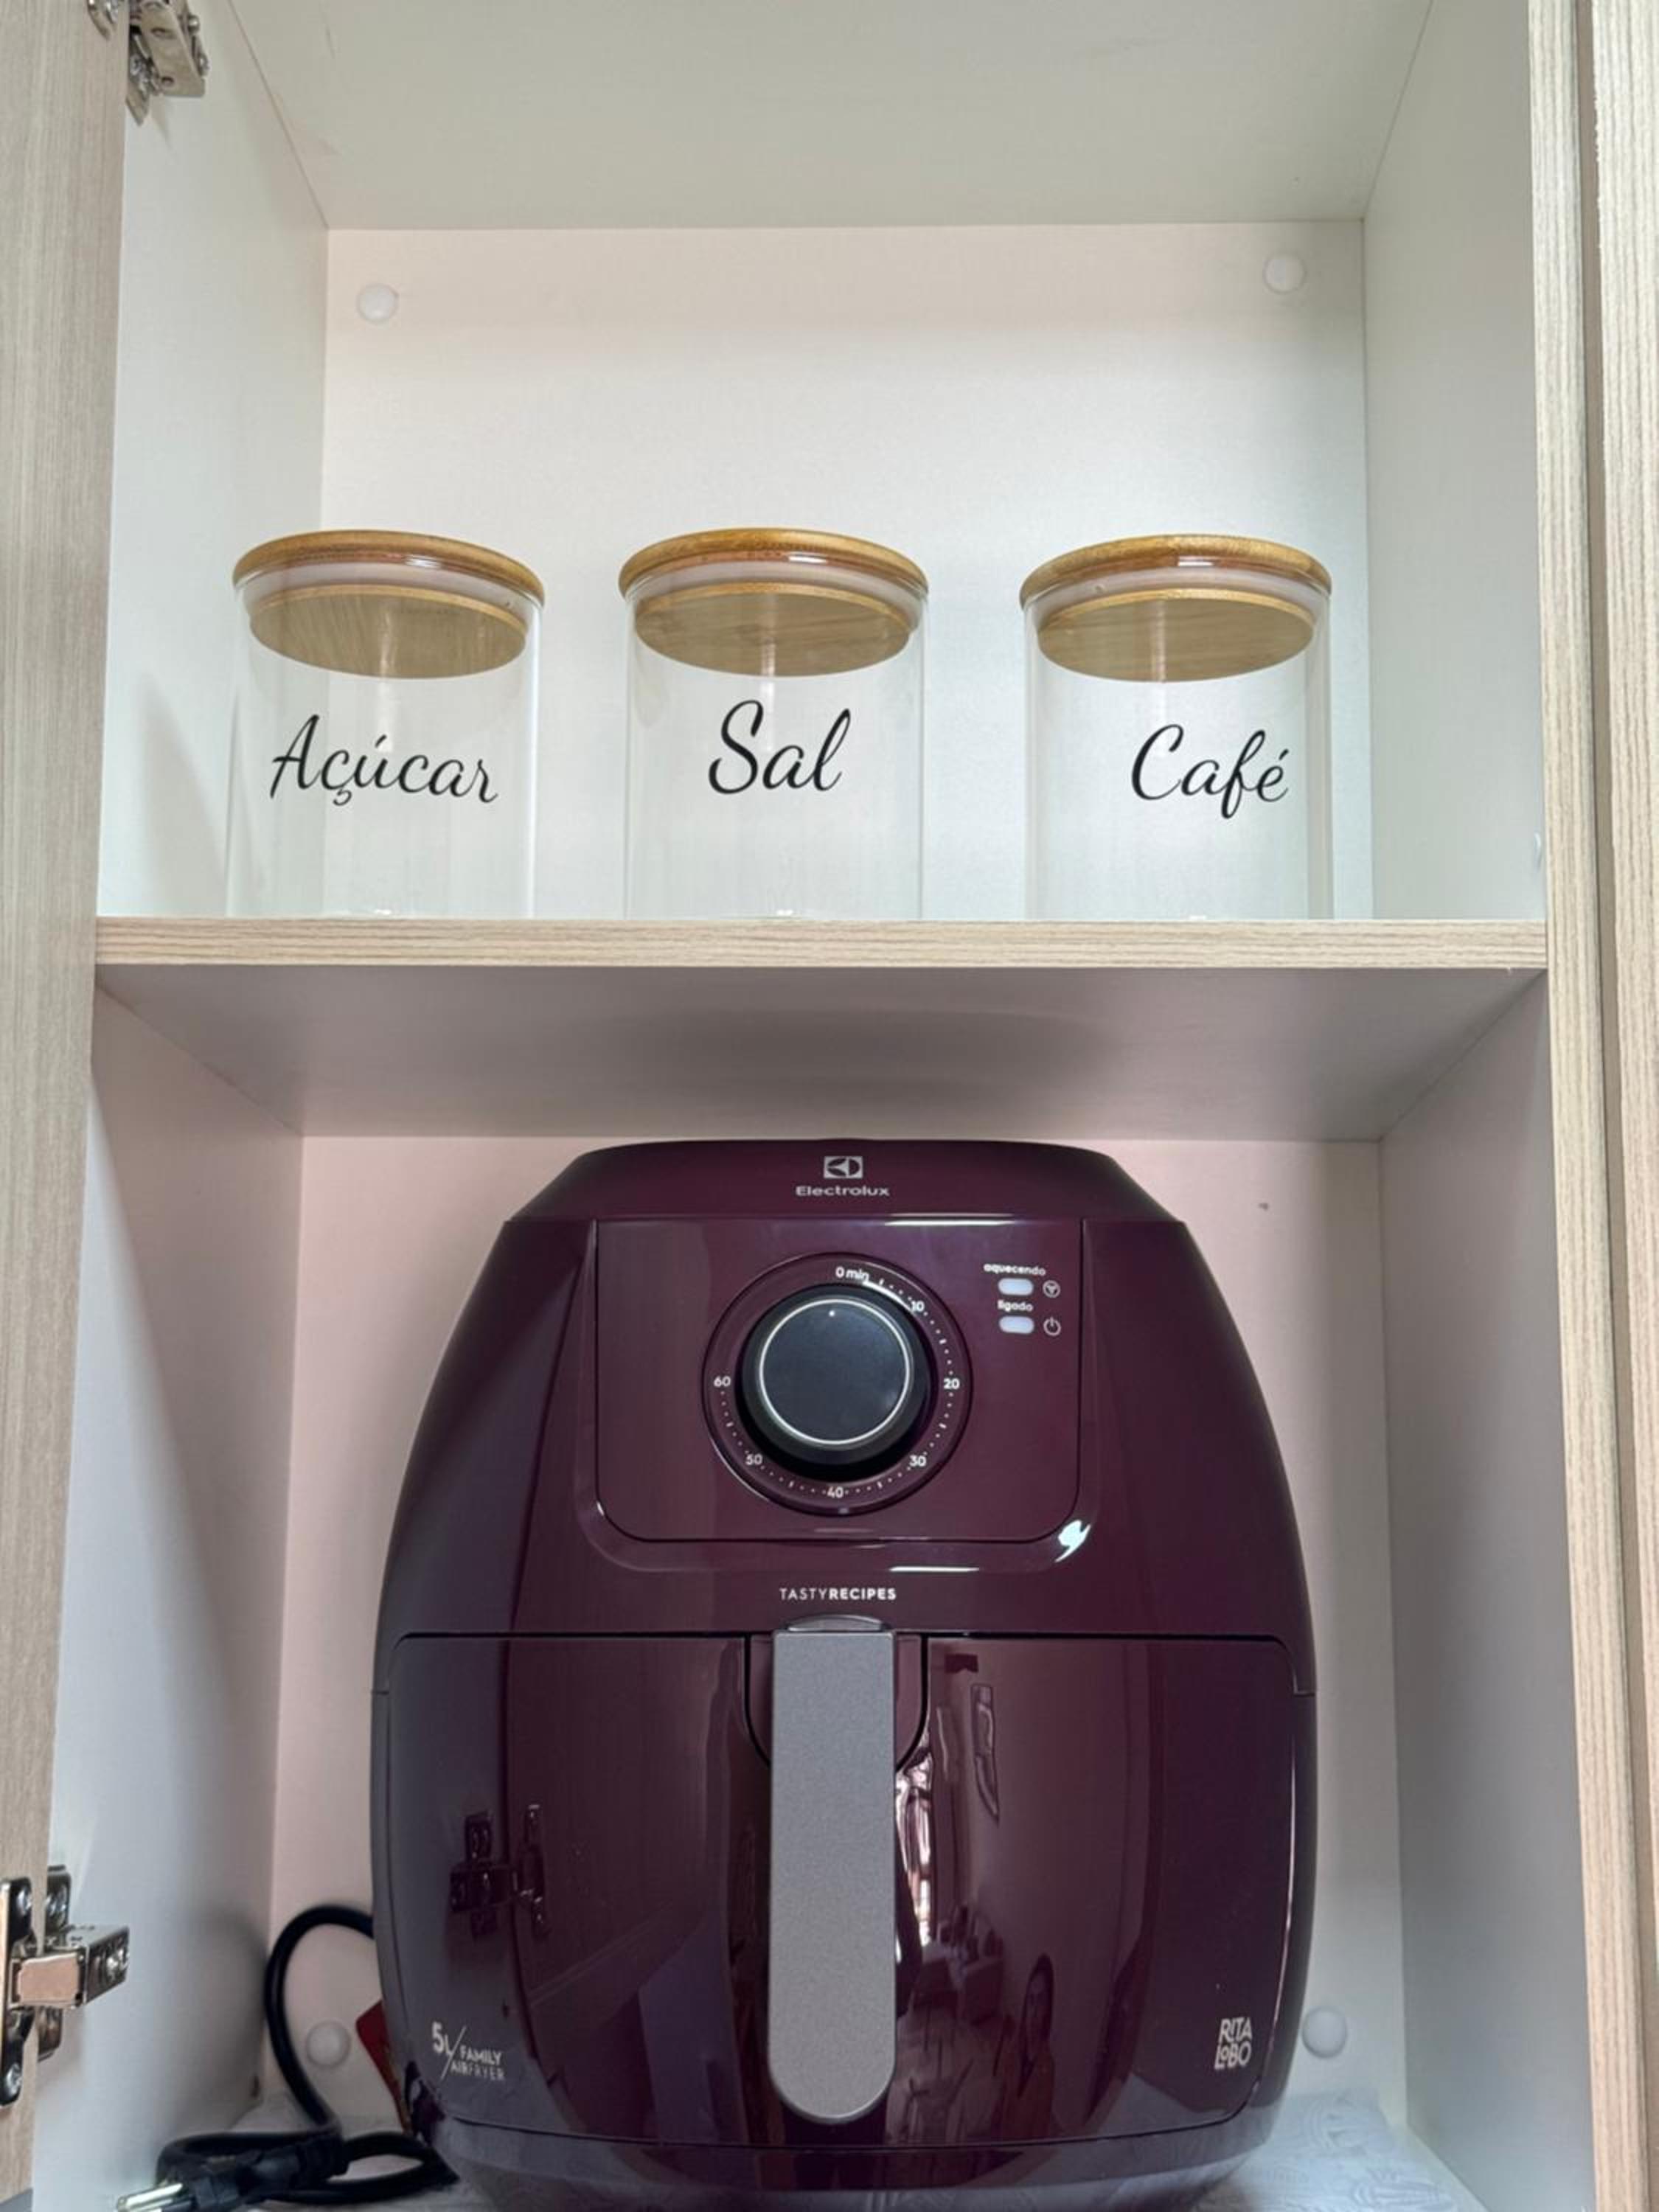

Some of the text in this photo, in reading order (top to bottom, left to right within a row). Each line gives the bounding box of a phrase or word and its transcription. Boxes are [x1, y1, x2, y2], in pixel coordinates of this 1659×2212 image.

[708, 700, 851, 795] Sal
[270, 714, 498, 806] Açúcar
[1131, 723, 1289, 819] Café
[796, 1185, 889, 1197] Electrolux
[835, 1267, 869, 1281] 0 min
[983, 1263, 1046, 1276] aquecendo
[910, 1301, 925, 1312] 10
[713, 1376, 731, 1387] 60
[943, 1378, 959, 1390] 20
[745, 1453, 762, 1465] 50
[909, 1455, 927, 1467] 30
[827, 1486, 844, 1498] 40
[1218, 2017, 1252, 2042] RITA
[459, 2045, 501, 2065] FAMILY
